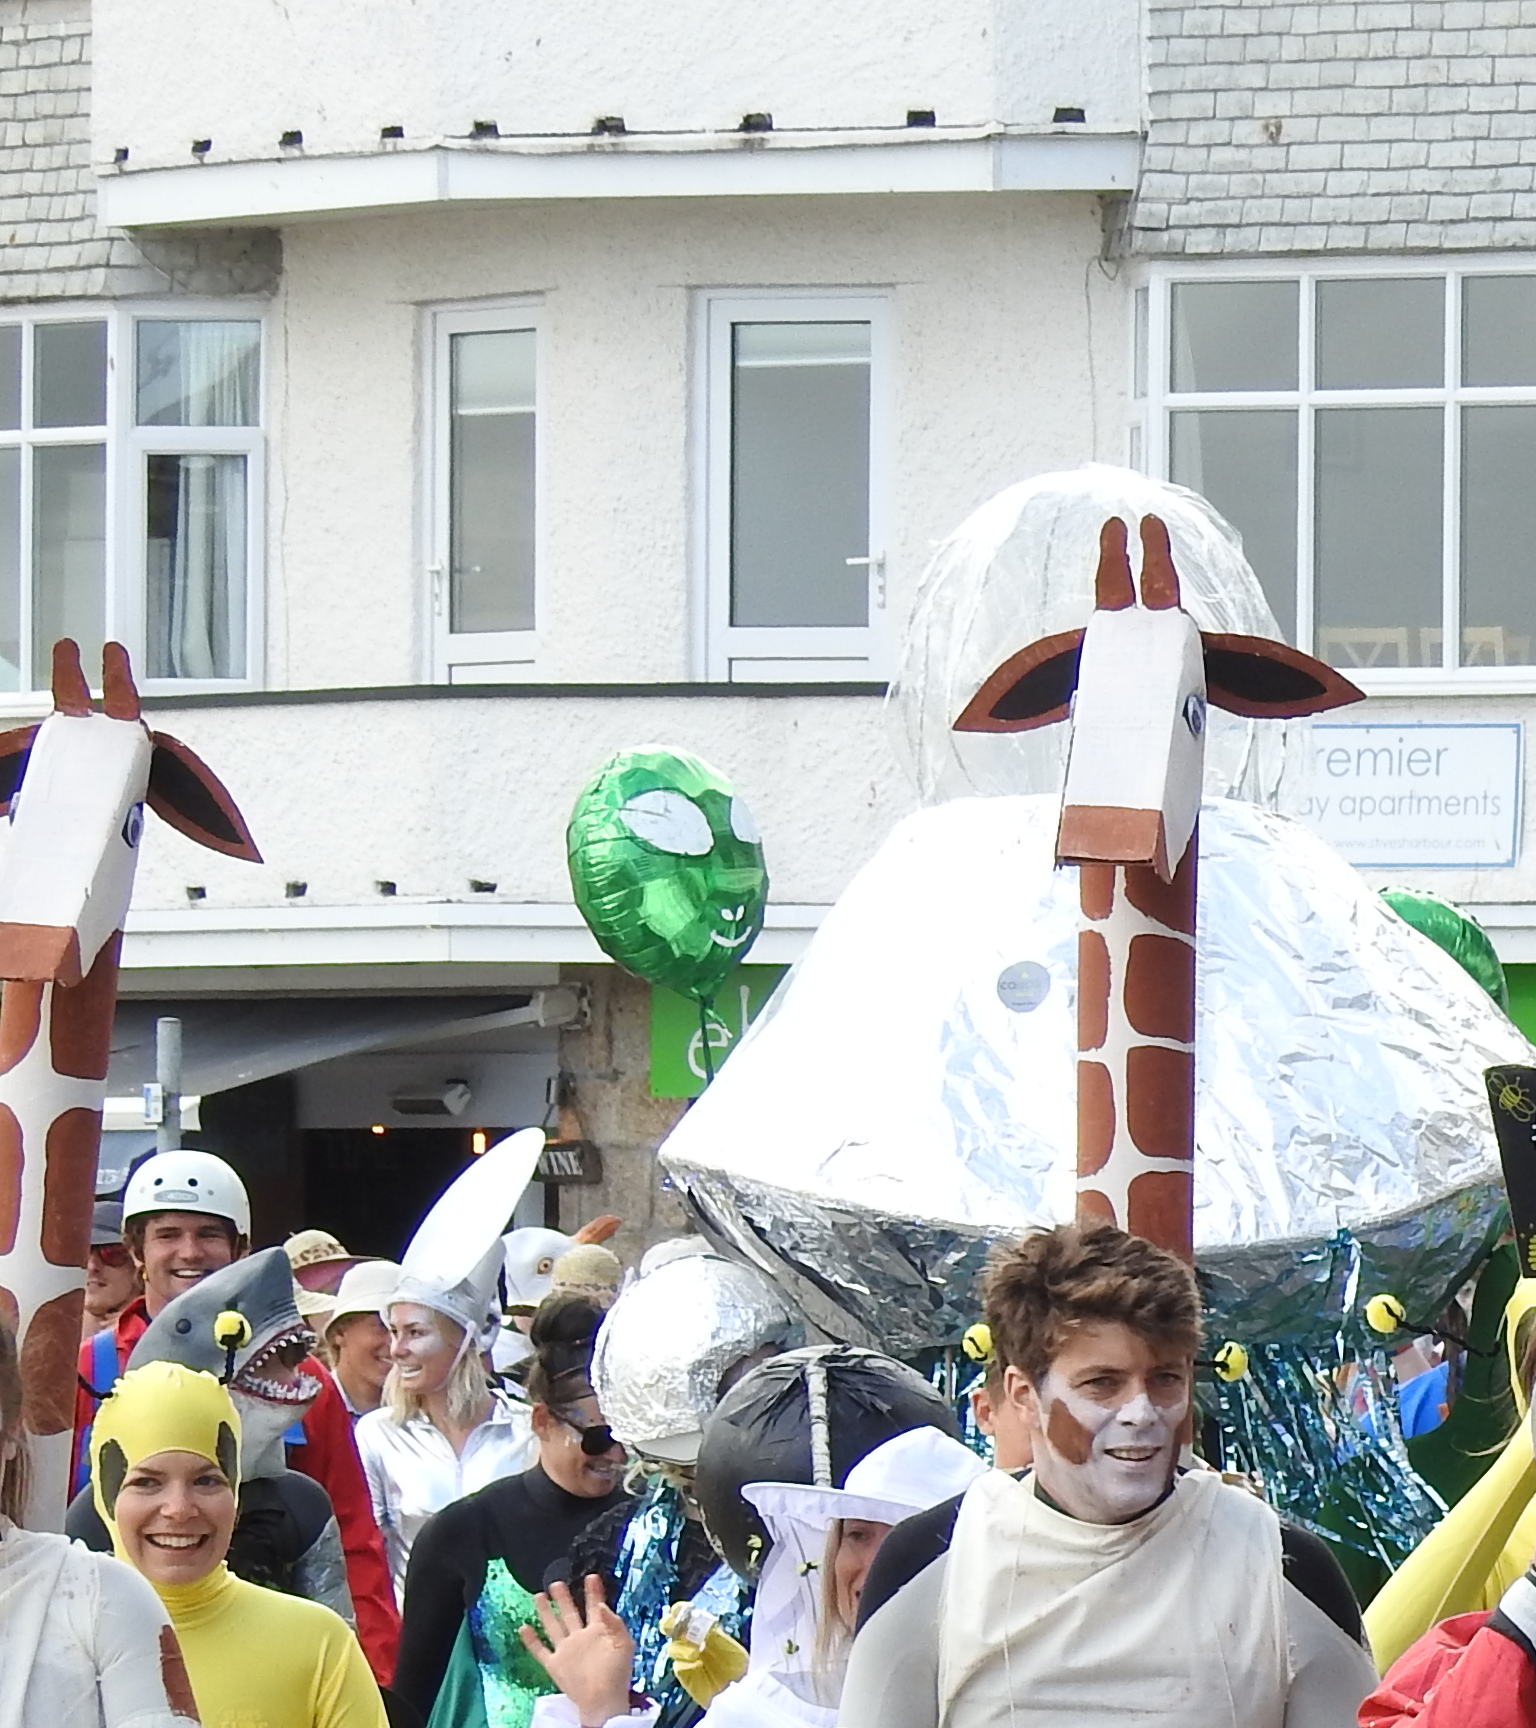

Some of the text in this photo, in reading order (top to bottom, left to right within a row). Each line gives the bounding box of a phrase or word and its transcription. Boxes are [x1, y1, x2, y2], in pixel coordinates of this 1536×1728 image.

[1315, 736, 1449, 778] remier
[1298, 788, 1502, 823] ay apartments
